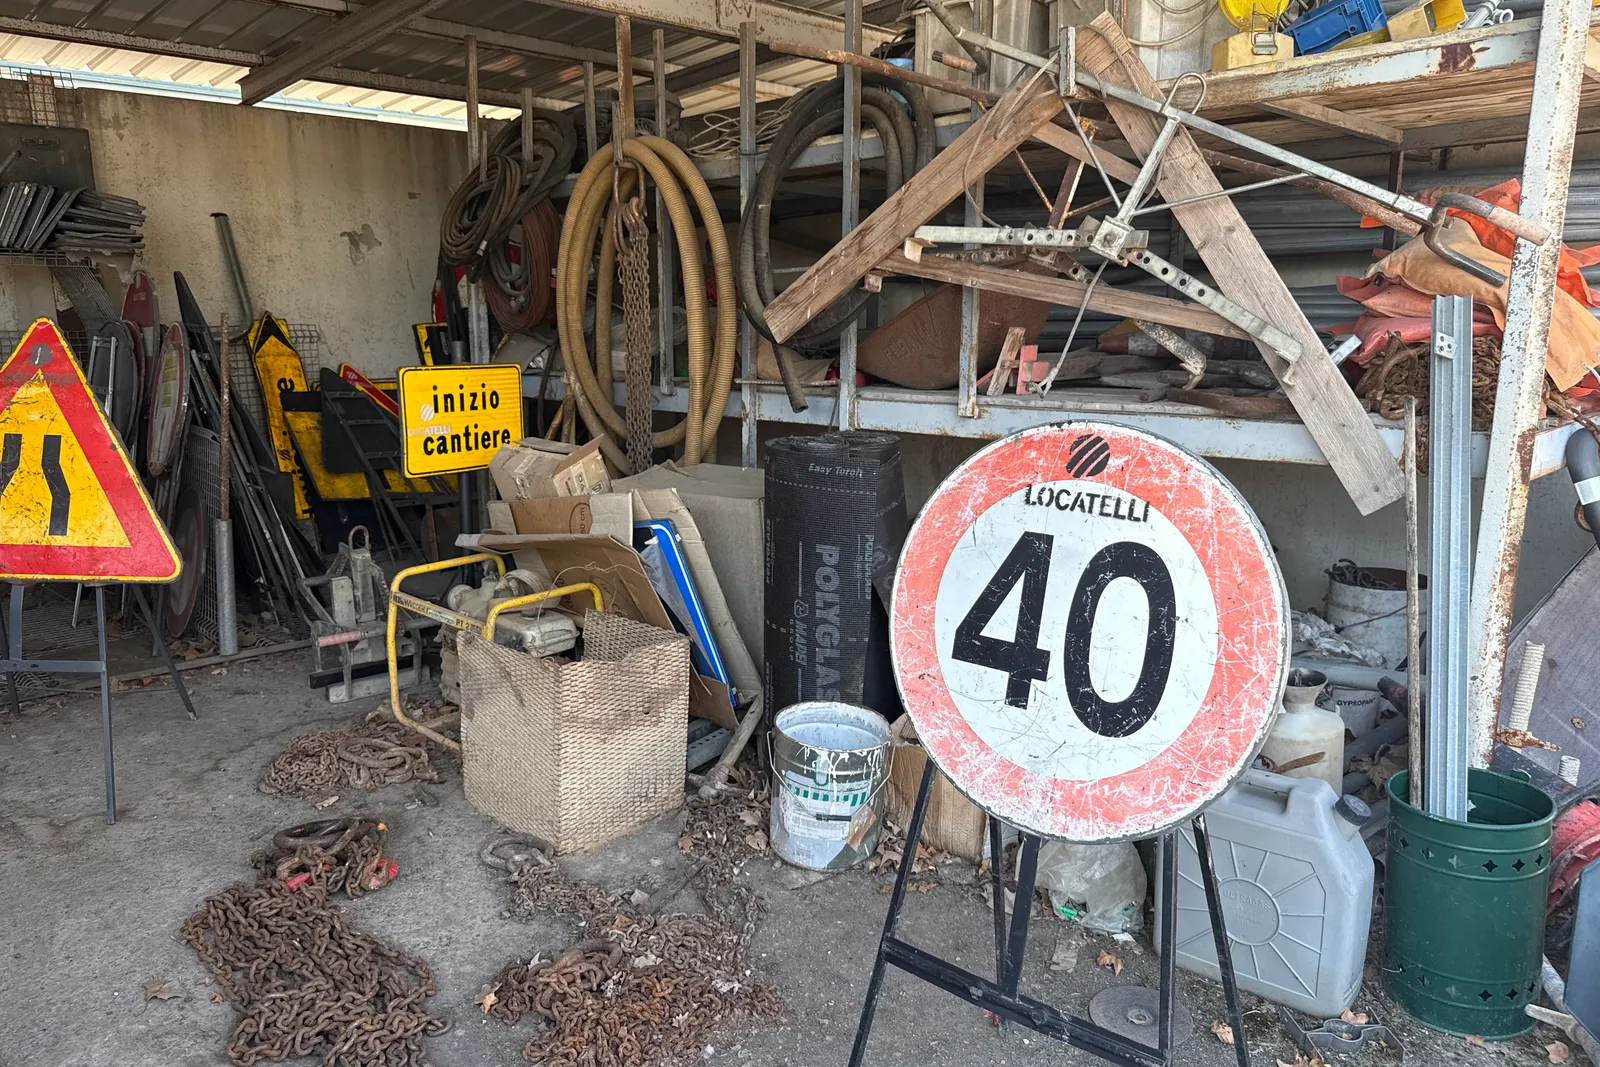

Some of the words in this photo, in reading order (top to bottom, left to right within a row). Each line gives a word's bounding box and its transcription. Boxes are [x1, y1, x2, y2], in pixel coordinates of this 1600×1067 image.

[432, 383, 499, 413] inizio
[407, 425, 451, 436] LOCATELLI
[423, 423, 511, 456] cantiere
[808, 463, 832, 475] Easy
[1024, 484, 1150, 522] LOCATELLI
[815, 543, 841, 702] POLYGLAS
[951, 530, 1177, 738] 40
[795, 619, 808, 666] MAPEI
[1223, 888, 1271, 912] ULTRAGAS
